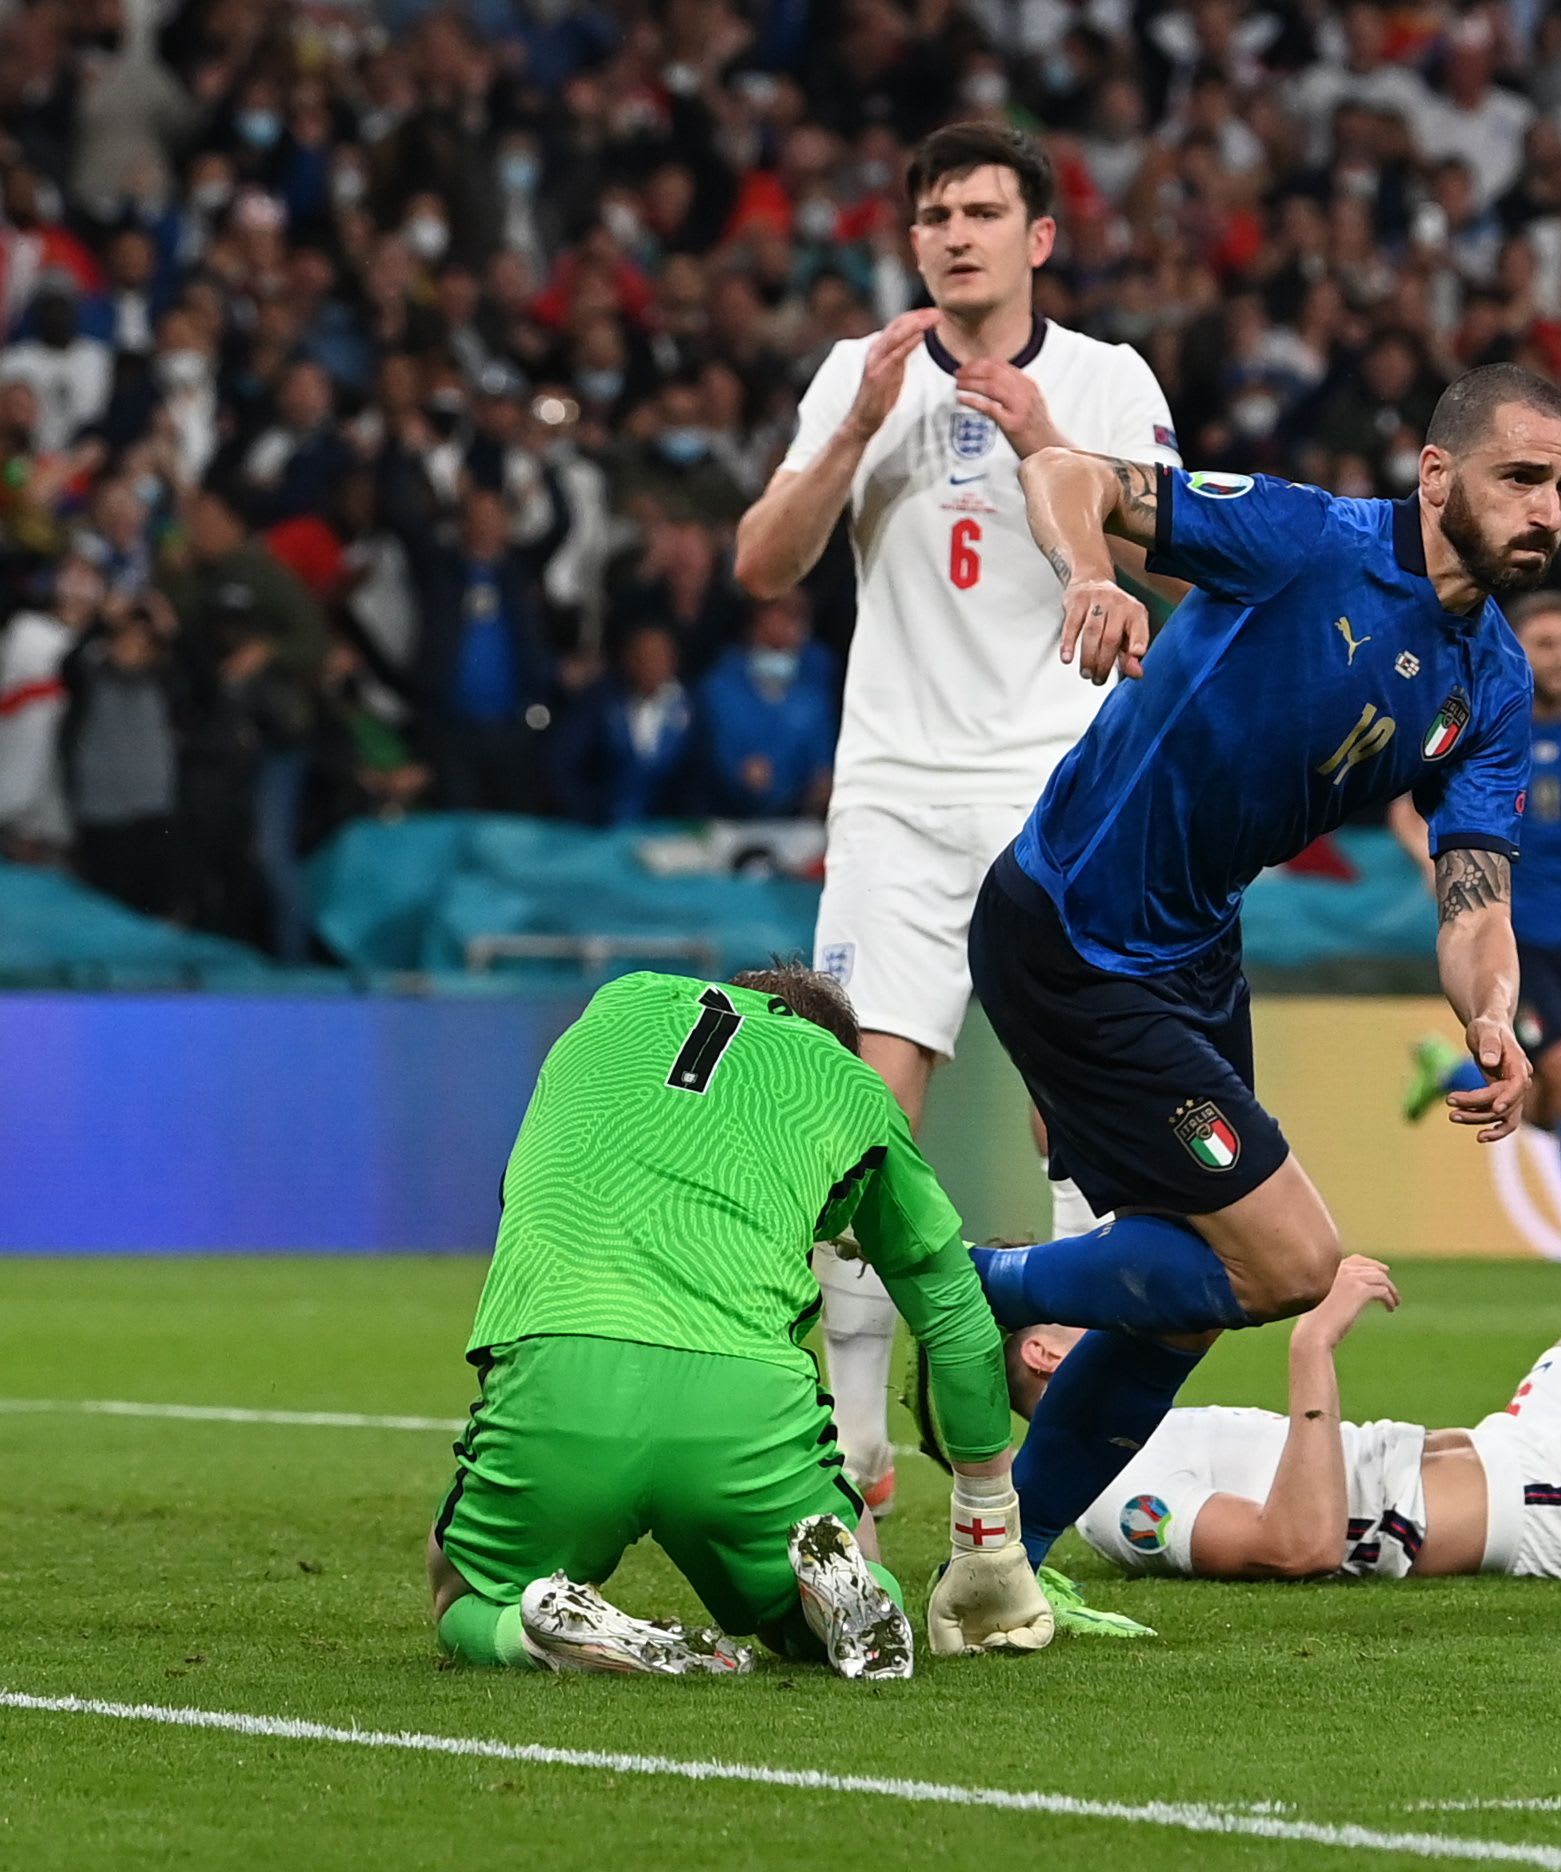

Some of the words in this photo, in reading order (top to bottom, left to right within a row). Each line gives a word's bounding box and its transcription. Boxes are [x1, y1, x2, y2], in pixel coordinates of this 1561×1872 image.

[949, 516, 982, 591] 6
[1317, 702, 1397, 786] 19
[664, 983, 746, 1096] 1
[1178, 1106, 1216, 1138] ITALIA
